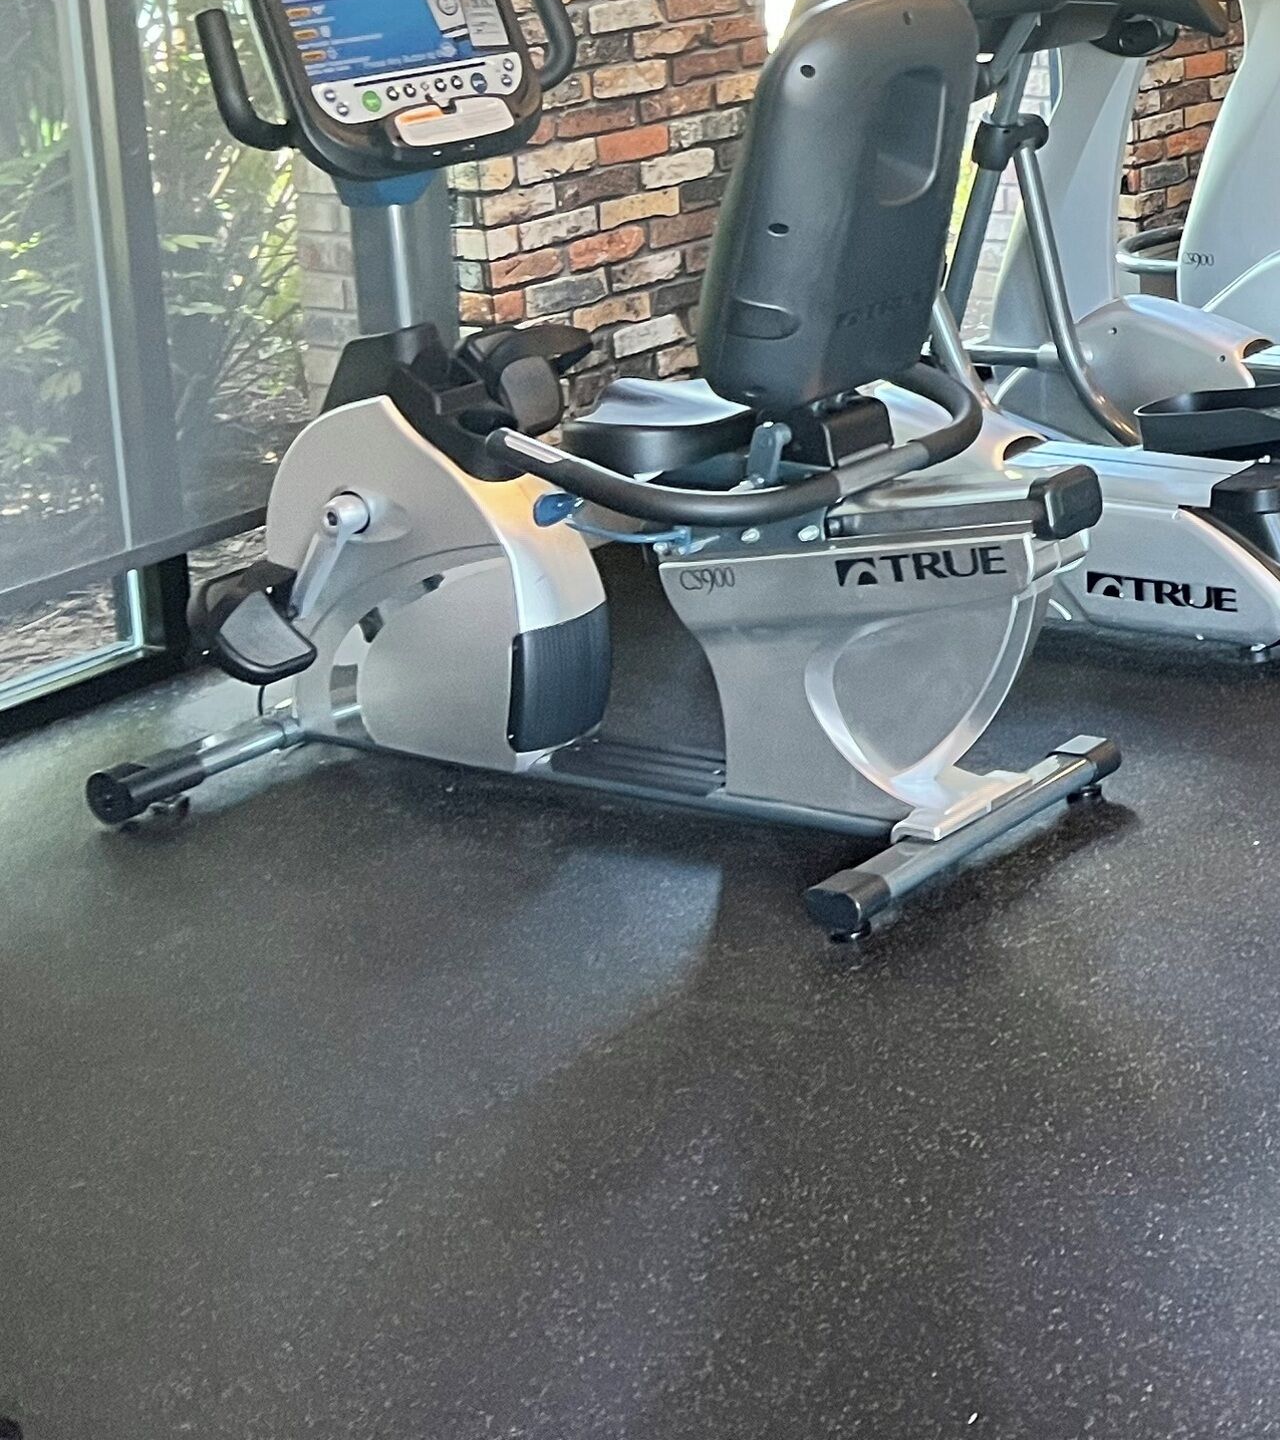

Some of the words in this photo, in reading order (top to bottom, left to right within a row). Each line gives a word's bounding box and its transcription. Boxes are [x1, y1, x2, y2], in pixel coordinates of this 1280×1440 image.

[680, 566, 736, 595] CS900
[879, 545, 1007, 583] TRUE
[1123, 576, 1238, 612] TRUE
